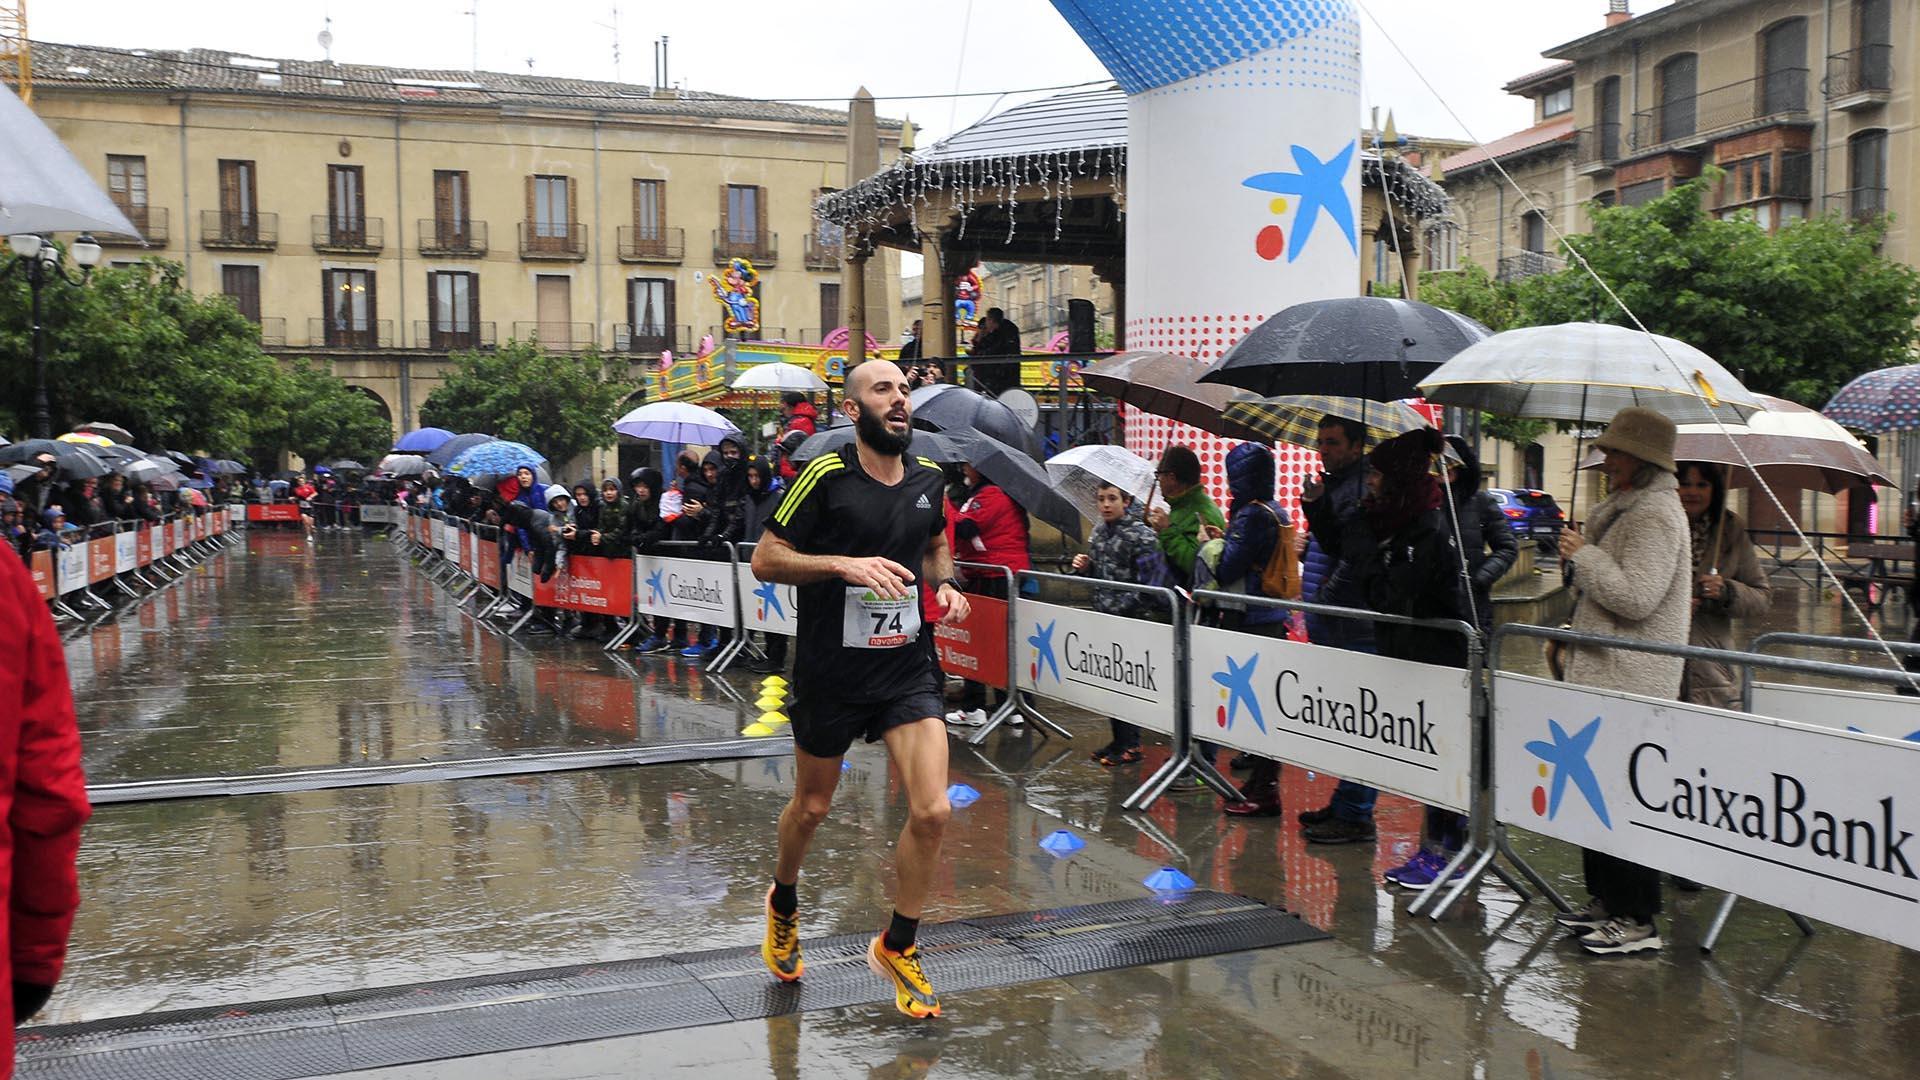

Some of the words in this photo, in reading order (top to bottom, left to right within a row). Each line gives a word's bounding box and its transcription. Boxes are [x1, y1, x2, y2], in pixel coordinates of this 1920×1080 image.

[668, 573, 724, 605] CaixaBank
[871, 611, 903, 635] 74
[1064, 631, 1158, 692] CaixaBank
[1275, 669, 1438, 756] CaixaBank
[1628, 742, 1919, 880] CaixaBank
